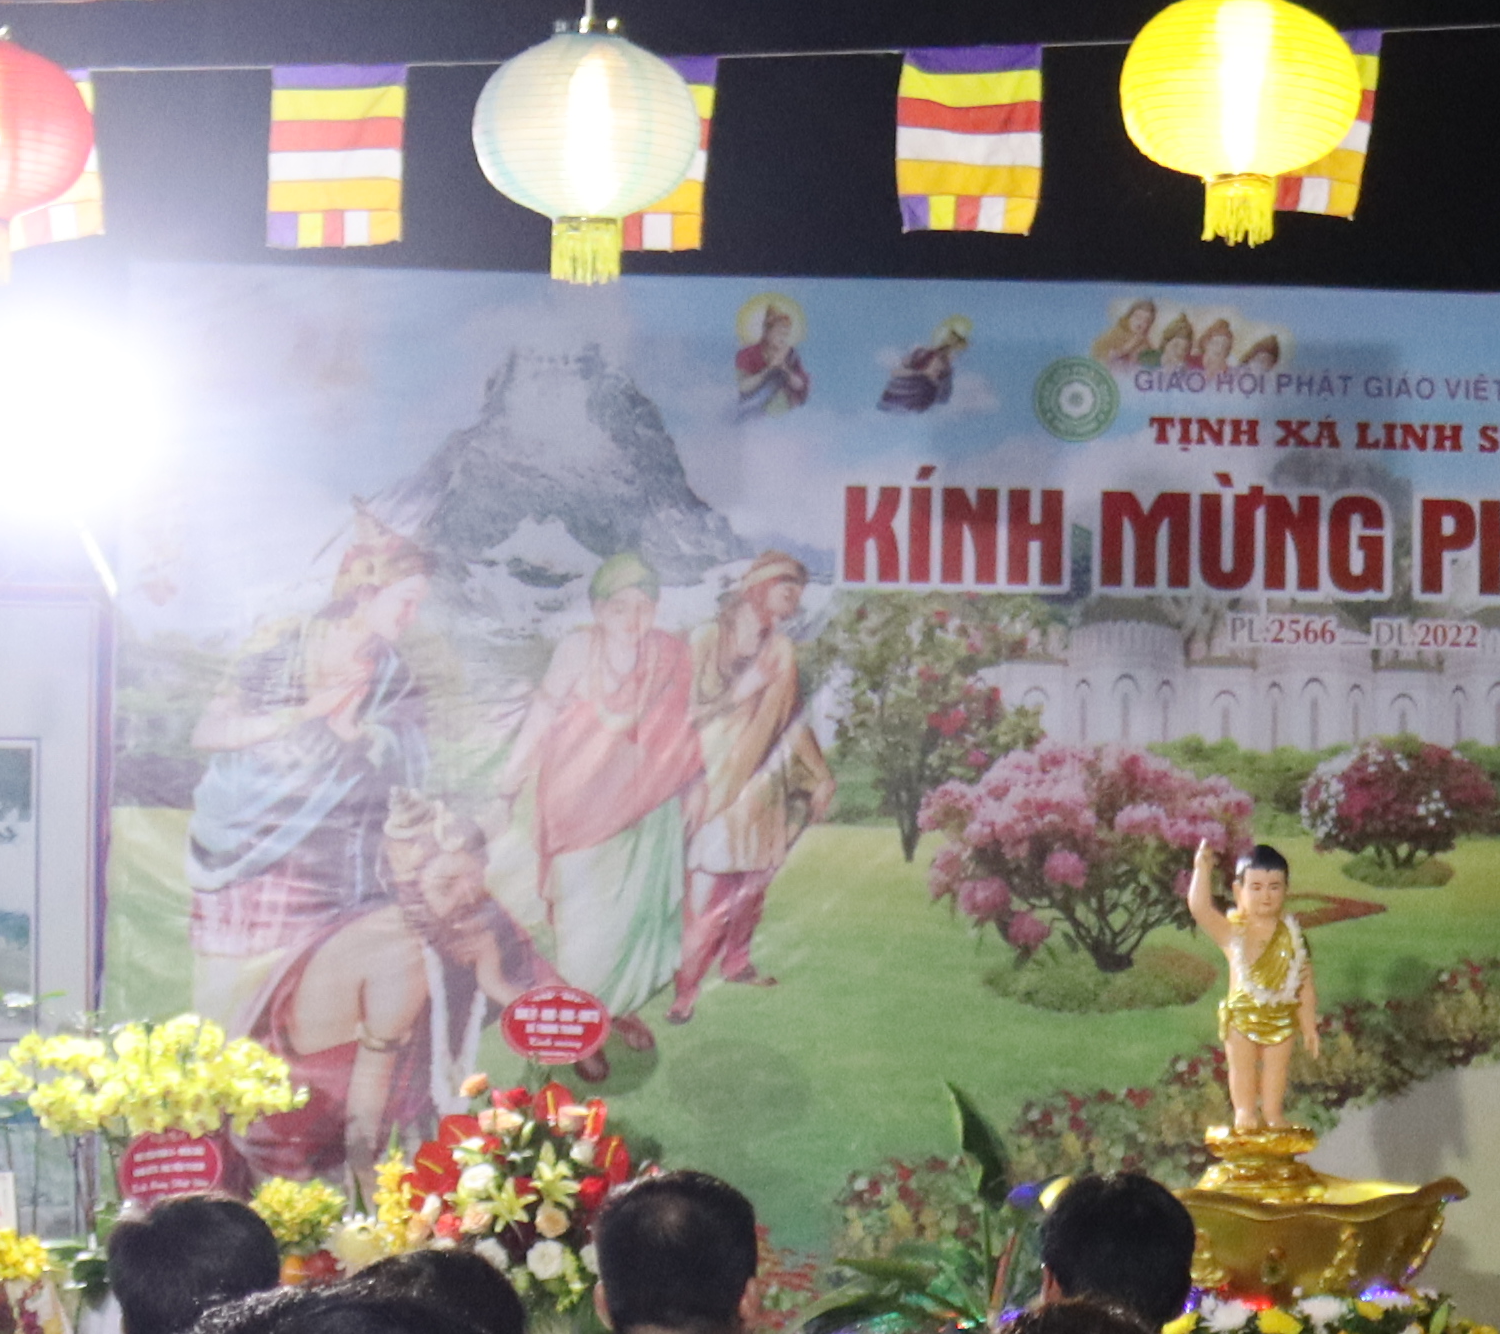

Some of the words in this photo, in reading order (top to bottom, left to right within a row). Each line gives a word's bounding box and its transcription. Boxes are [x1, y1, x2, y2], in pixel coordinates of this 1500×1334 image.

[1134, 365, 1206, 393] GIÁO
[1216, 366, 1265, 396] HỘI
[1277, 368, 1352, 400] PHẬT
[1364, 371, 1436, 400] GIÁO
[1149, 417, 1259, 451] TỊNH
[1275, 415, 1340, 449] XÁ
[1356, 422, 1463, 452] LINH
[844, 465, 1064, 585] KÍNH
[1100, 471, 1385, 594] MỪNG
